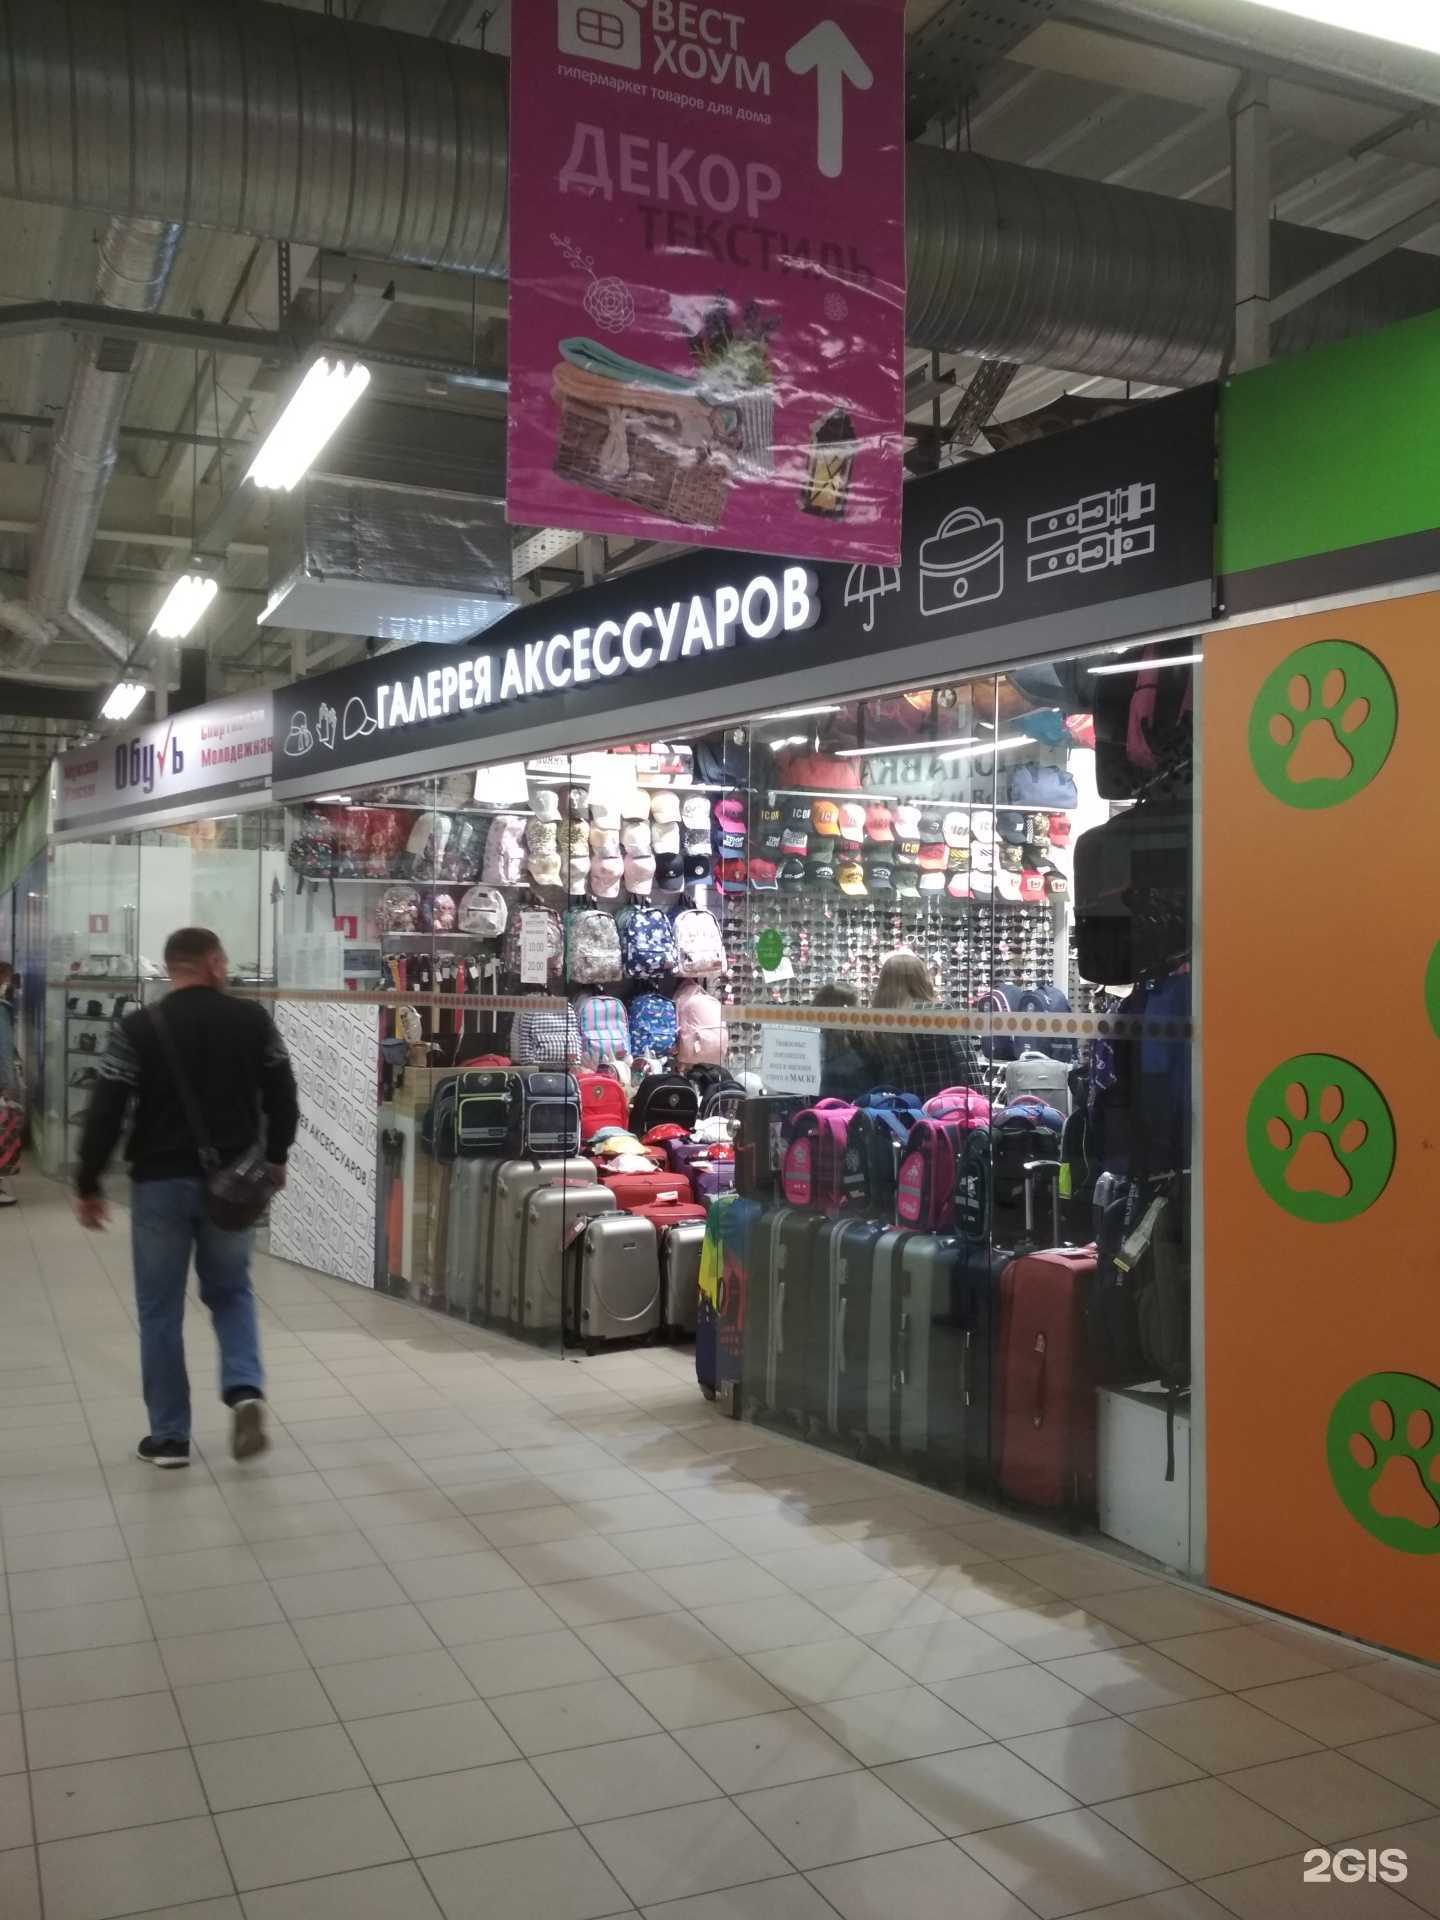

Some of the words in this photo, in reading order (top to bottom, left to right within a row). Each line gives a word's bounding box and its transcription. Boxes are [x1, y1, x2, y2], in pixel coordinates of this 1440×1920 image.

[652, 0, 745, 50] ВЕСТ
[557, 63, 648, 97] гипермаркет
[650, 86, 704, 109] товаров
[707, 102, 733, 116] для
[736, 108, 772, 125] дома
[653, 35, 771, 96] ХОУМ
[557, 122, 783, 218] ДЕКОР
[637, 204, 875, 286] ТЕКСТИЛЬ
[376, 655, 492, 729] ГАЛЕРЕЯ
[499, 566, 818, 700] АКСЕССУАРОВ
